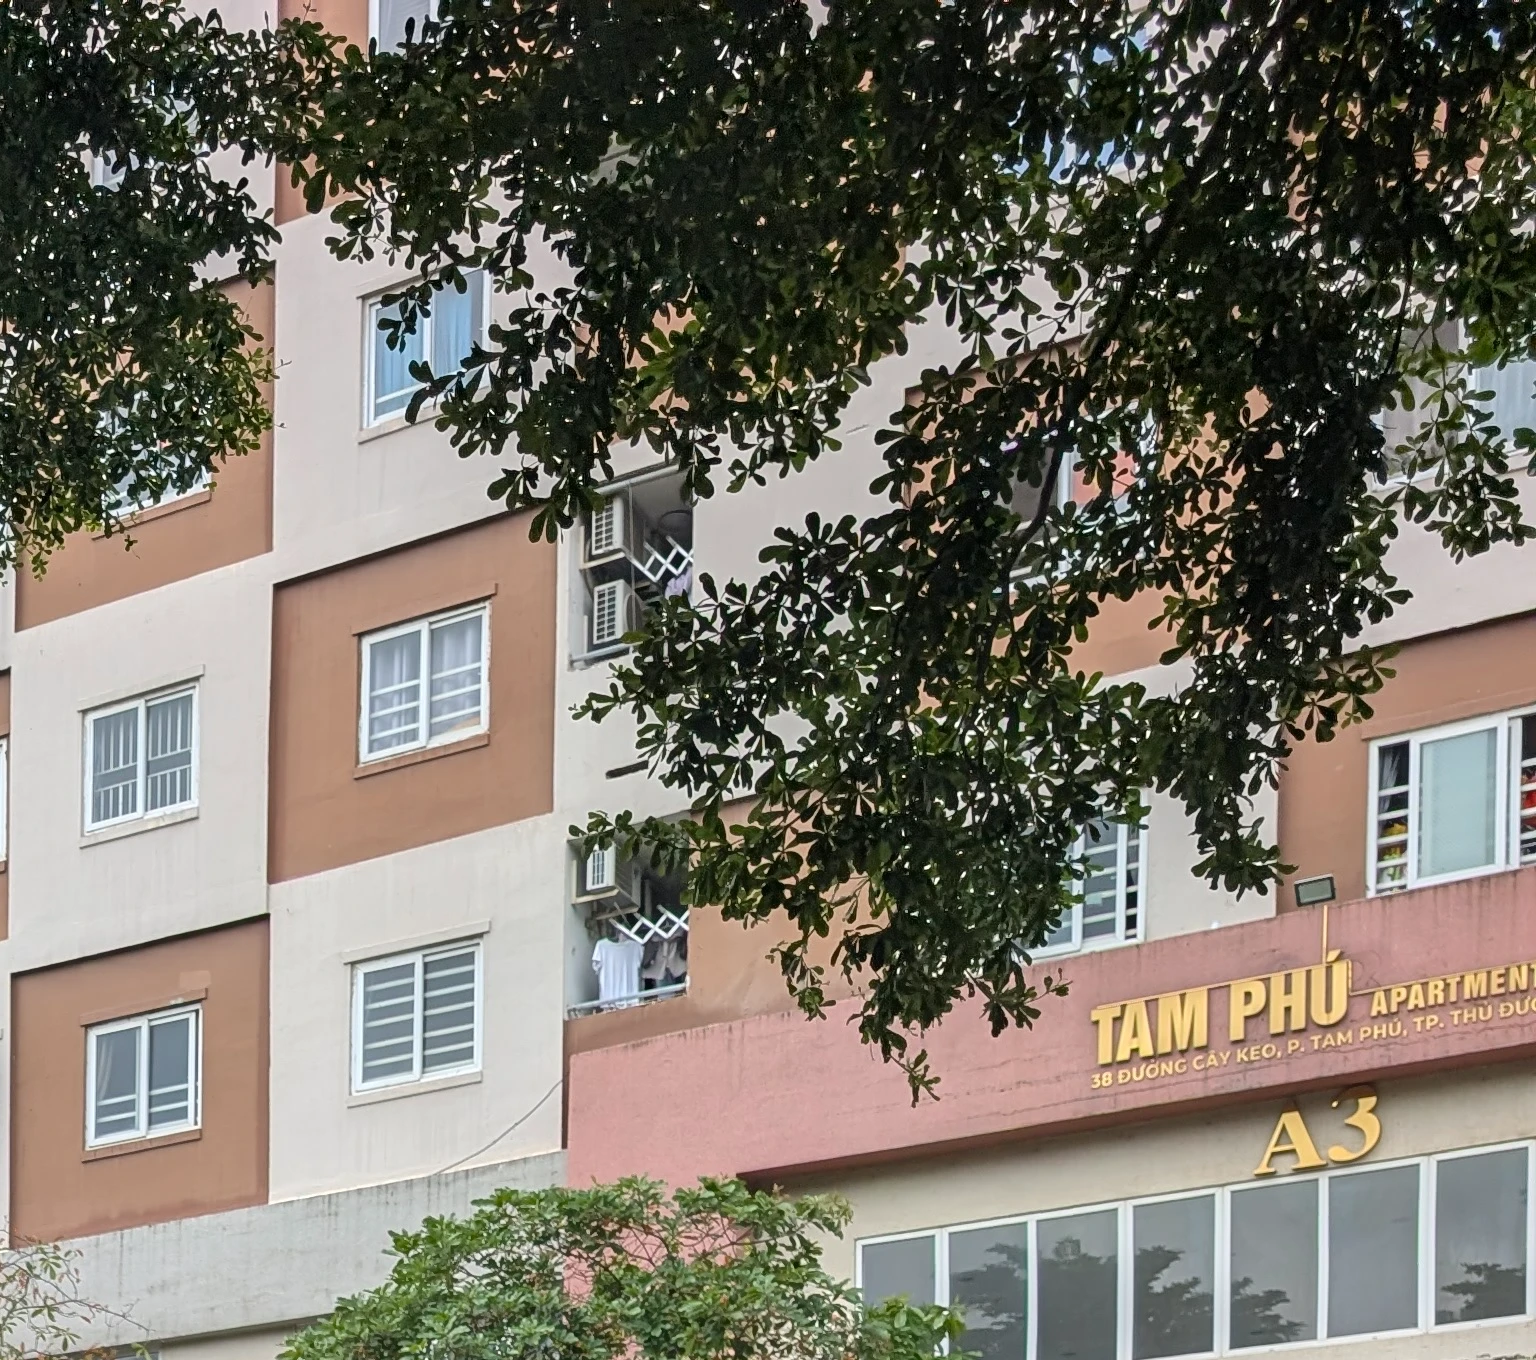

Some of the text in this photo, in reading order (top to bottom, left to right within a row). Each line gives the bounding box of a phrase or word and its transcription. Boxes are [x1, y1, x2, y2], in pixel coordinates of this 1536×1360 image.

[1091, 949, 1348, 1065] TAM PHÚ
[1091, 1071, 1113, 1089] 38
[1192, 1050, 1231, 1071] CÂY
[1236, 1043, 1282, 1063] KEO,
[1287, 1038, 1305, 1054] P.
[1310, 1030, 1353, 1051] TAM
[1359, 1018, 1409, 1042] PHÚ,
[1413, 1014, 1445, 1033] TP.
[1449, 999, 1493, 1026] THỦ
[1254, 1085, 1381, 1176] A3
